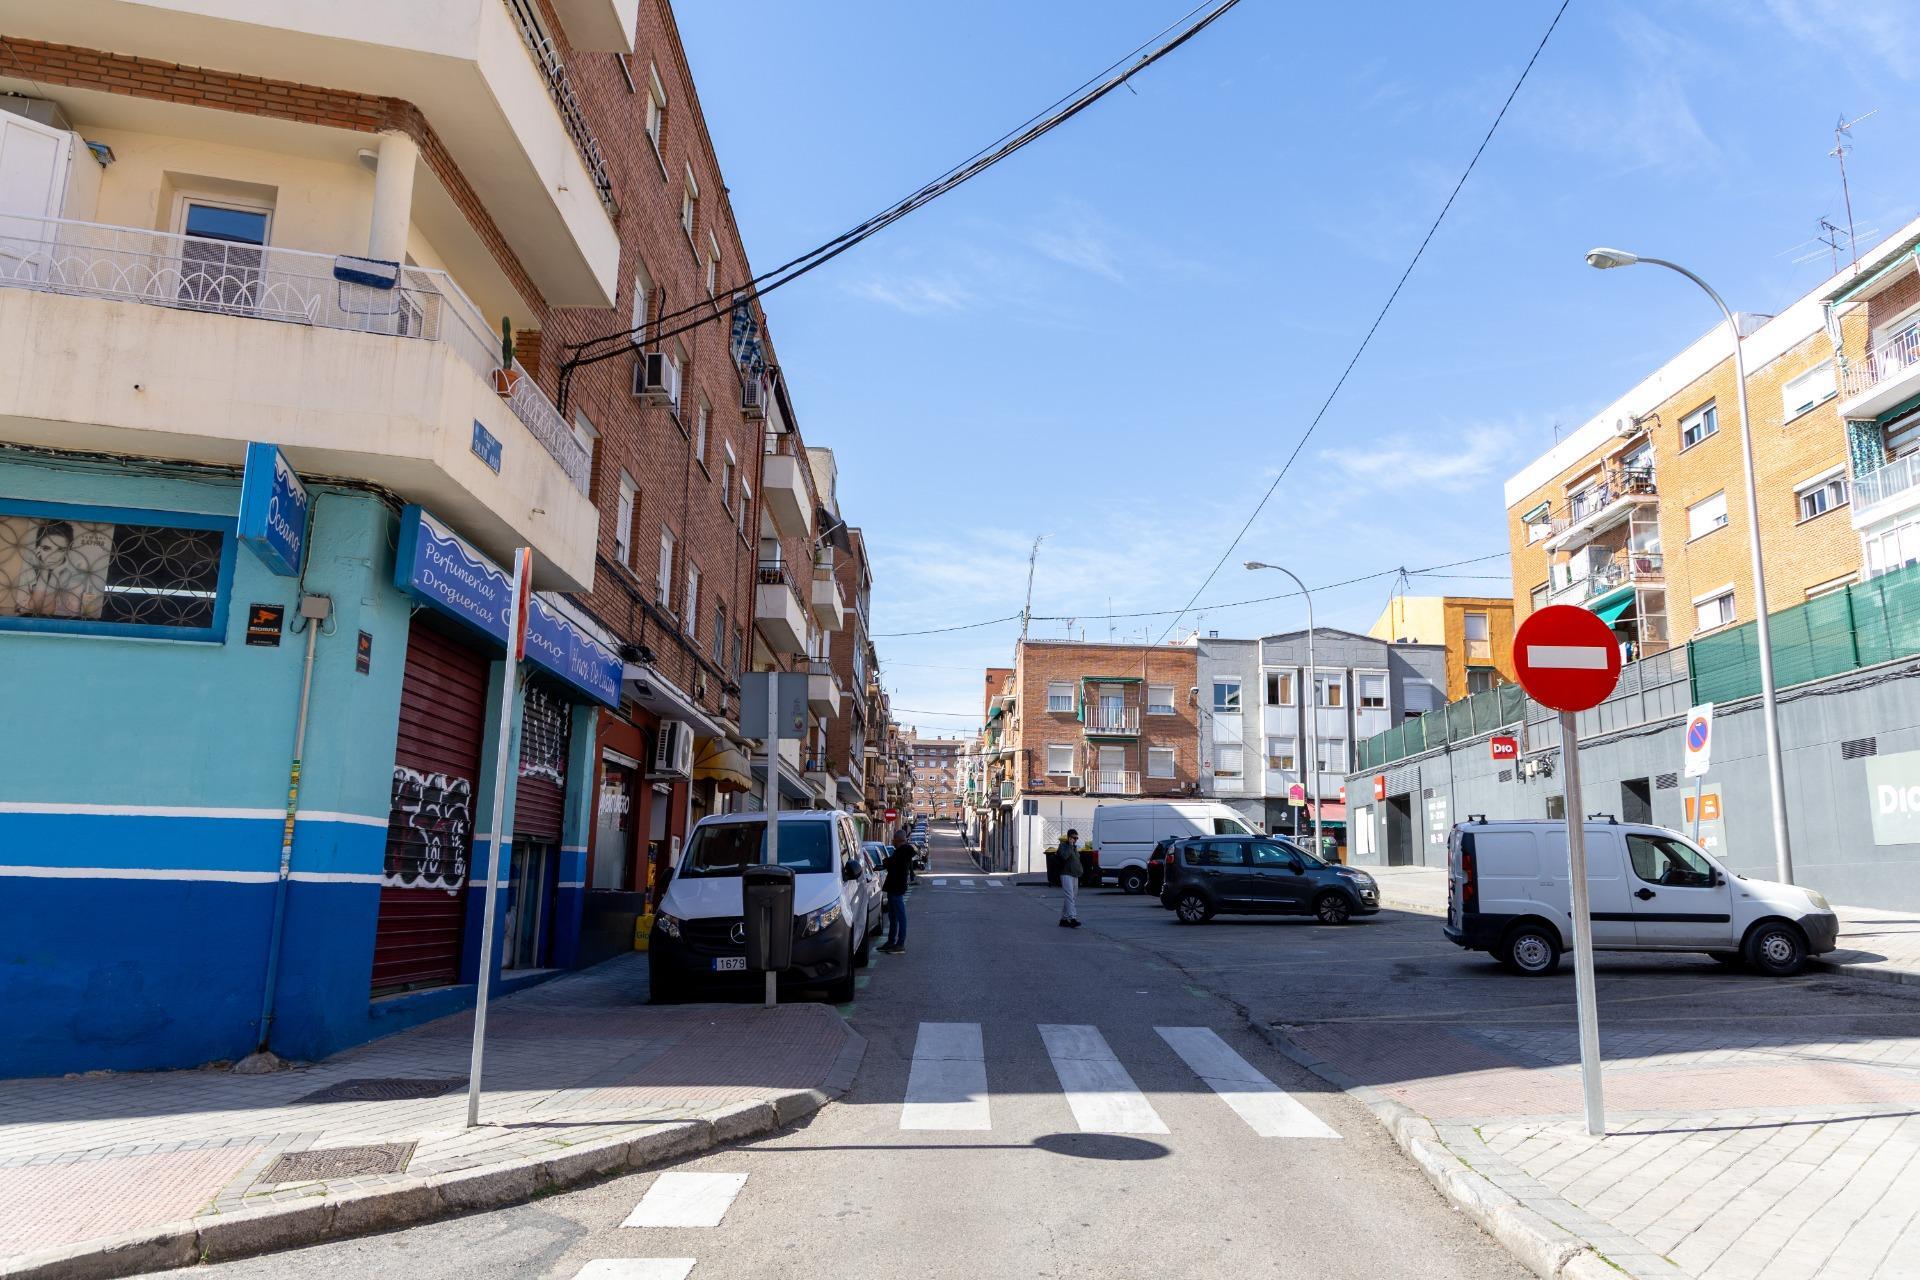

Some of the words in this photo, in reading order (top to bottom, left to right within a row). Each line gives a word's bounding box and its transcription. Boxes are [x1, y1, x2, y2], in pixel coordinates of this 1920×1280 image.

[268, 495, 301, 553] Oceano
[501, 607, 566, 658] Oeano
[636, 931, 649, 939] Glo
[720, 959, 745, 970] 1679
